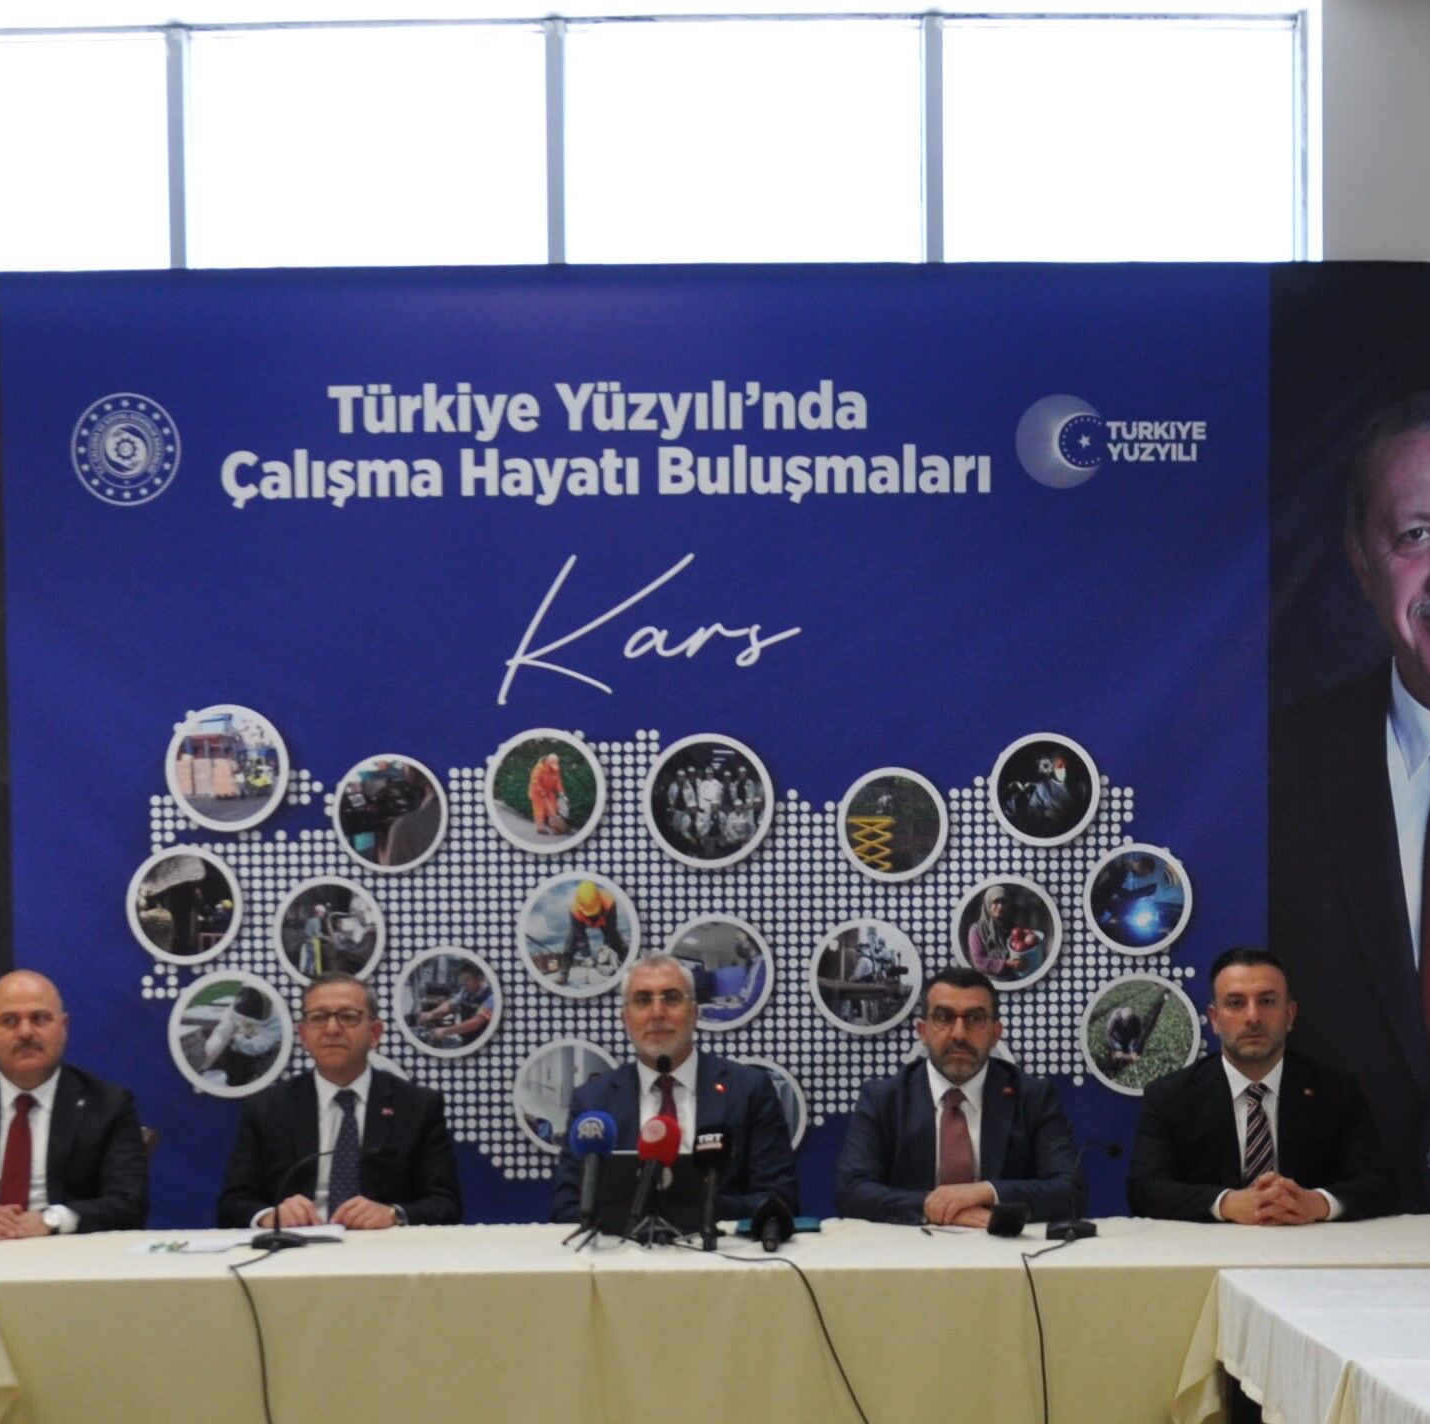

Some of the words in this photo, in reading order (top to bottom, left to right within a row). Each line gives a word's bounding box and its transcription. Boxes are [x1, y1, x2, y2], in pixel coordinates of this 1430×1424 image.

[327, 382, 540, 440] Türkiye
[220, 449, 444, 509] Çalışma
[460, 448, 640, 505] Hayatı
[658, 444, 991, 504] Buluşmaları
[498, 553, 801, 706] Kars
[698, 1132, 724, 1143] TRT
